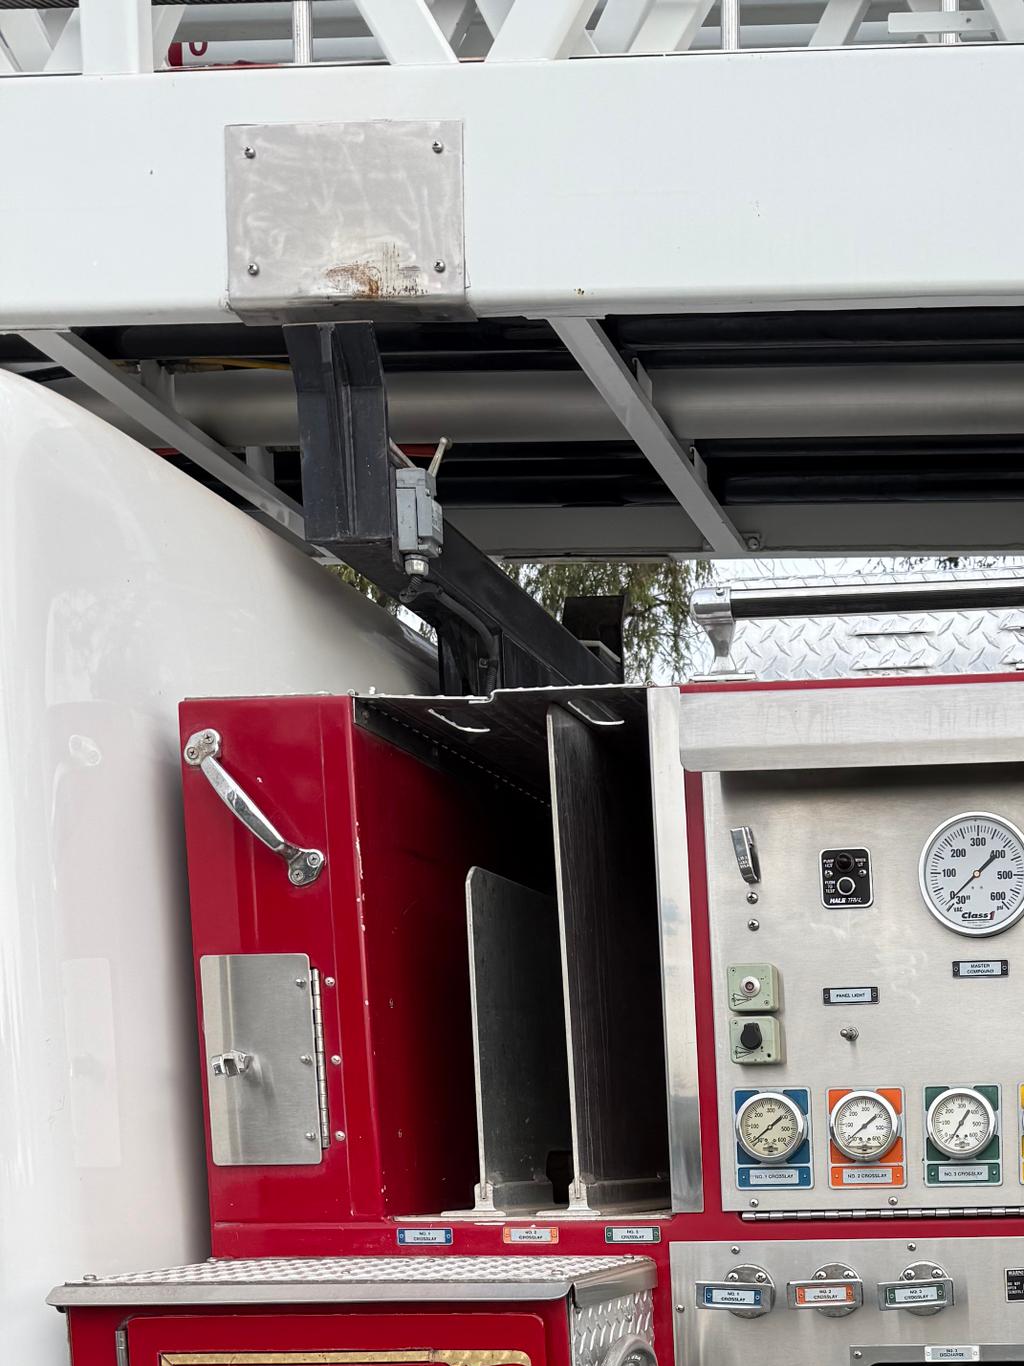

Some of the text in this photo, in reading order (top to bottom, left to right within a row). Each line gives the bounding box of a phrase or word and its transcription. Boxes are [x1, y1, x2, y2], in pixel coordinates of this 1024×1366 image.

[970, 837, 986, 847] 300
[950, 849, 966, 858] 200
[989, 850, 1006, 859] 400
[942, 868, 956, 878] 100
[997, 870, 1013, 880] 500
[990, 892, 1006, 901] 600
